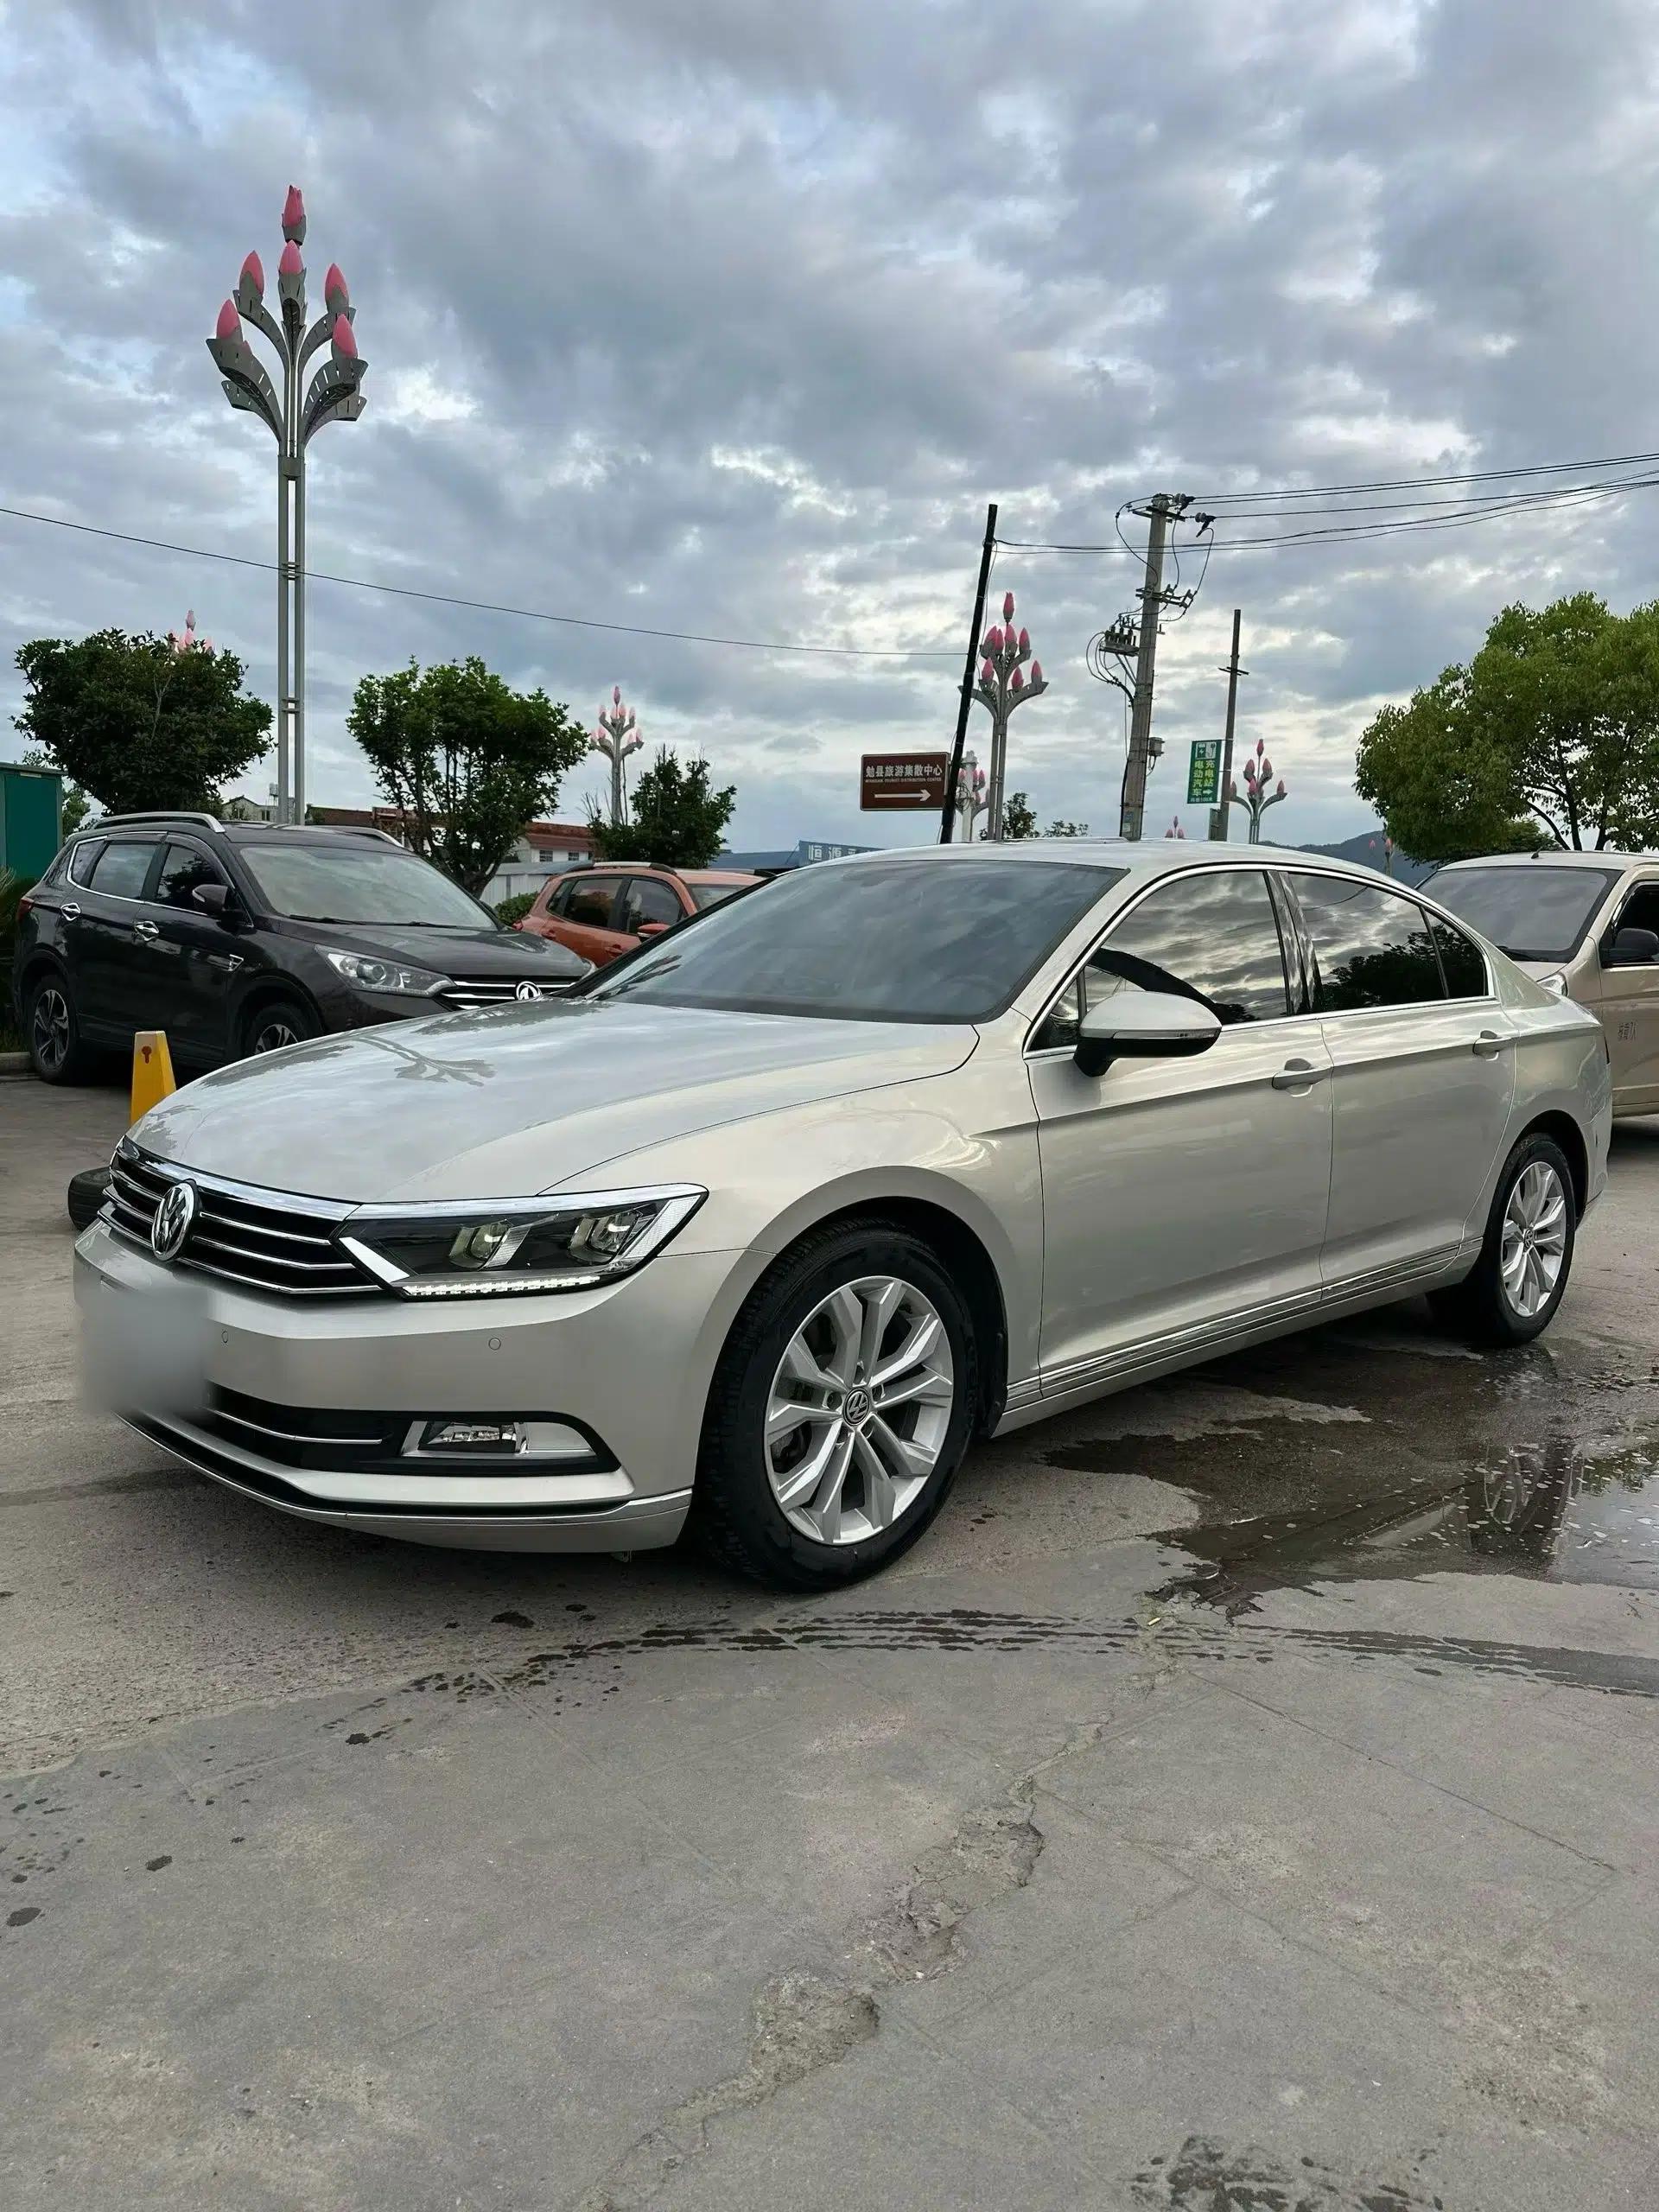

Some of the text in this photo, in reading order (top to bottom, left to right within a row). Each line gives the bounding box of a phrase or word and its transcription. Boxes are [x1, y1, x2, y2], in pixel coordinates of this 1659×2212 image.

[866, 764, 943, 778] 勉县旅游集散中心
